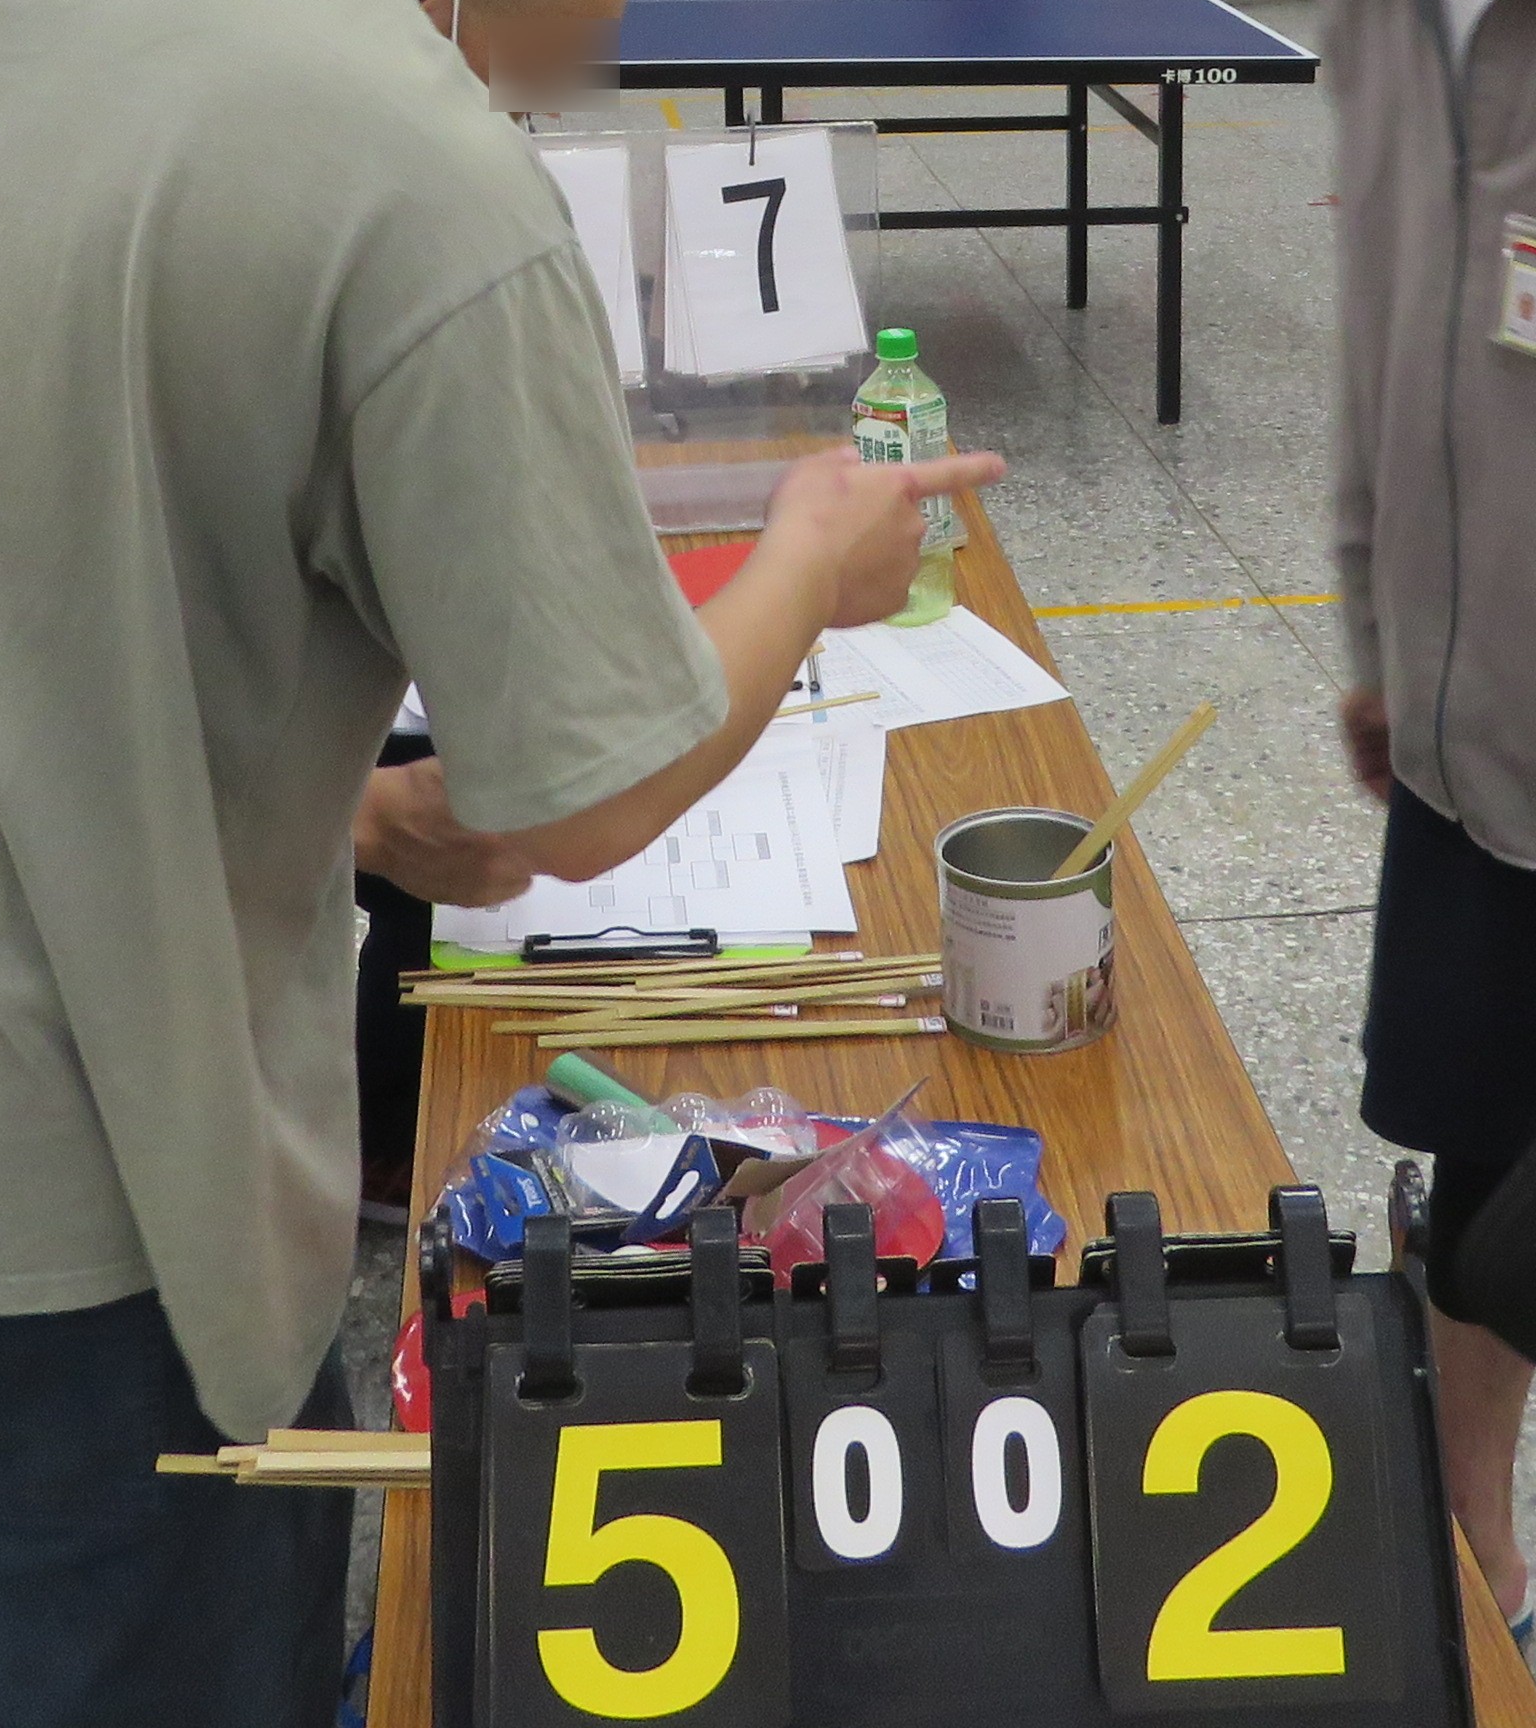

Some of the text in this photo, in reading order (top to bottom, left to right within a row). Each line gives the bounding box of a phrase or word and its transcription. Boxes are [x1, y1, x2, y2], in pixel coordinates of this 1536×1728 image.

[721, 178, 787, 314] 7
[537, 1390, 1345, 1719] 5 0 0 2
